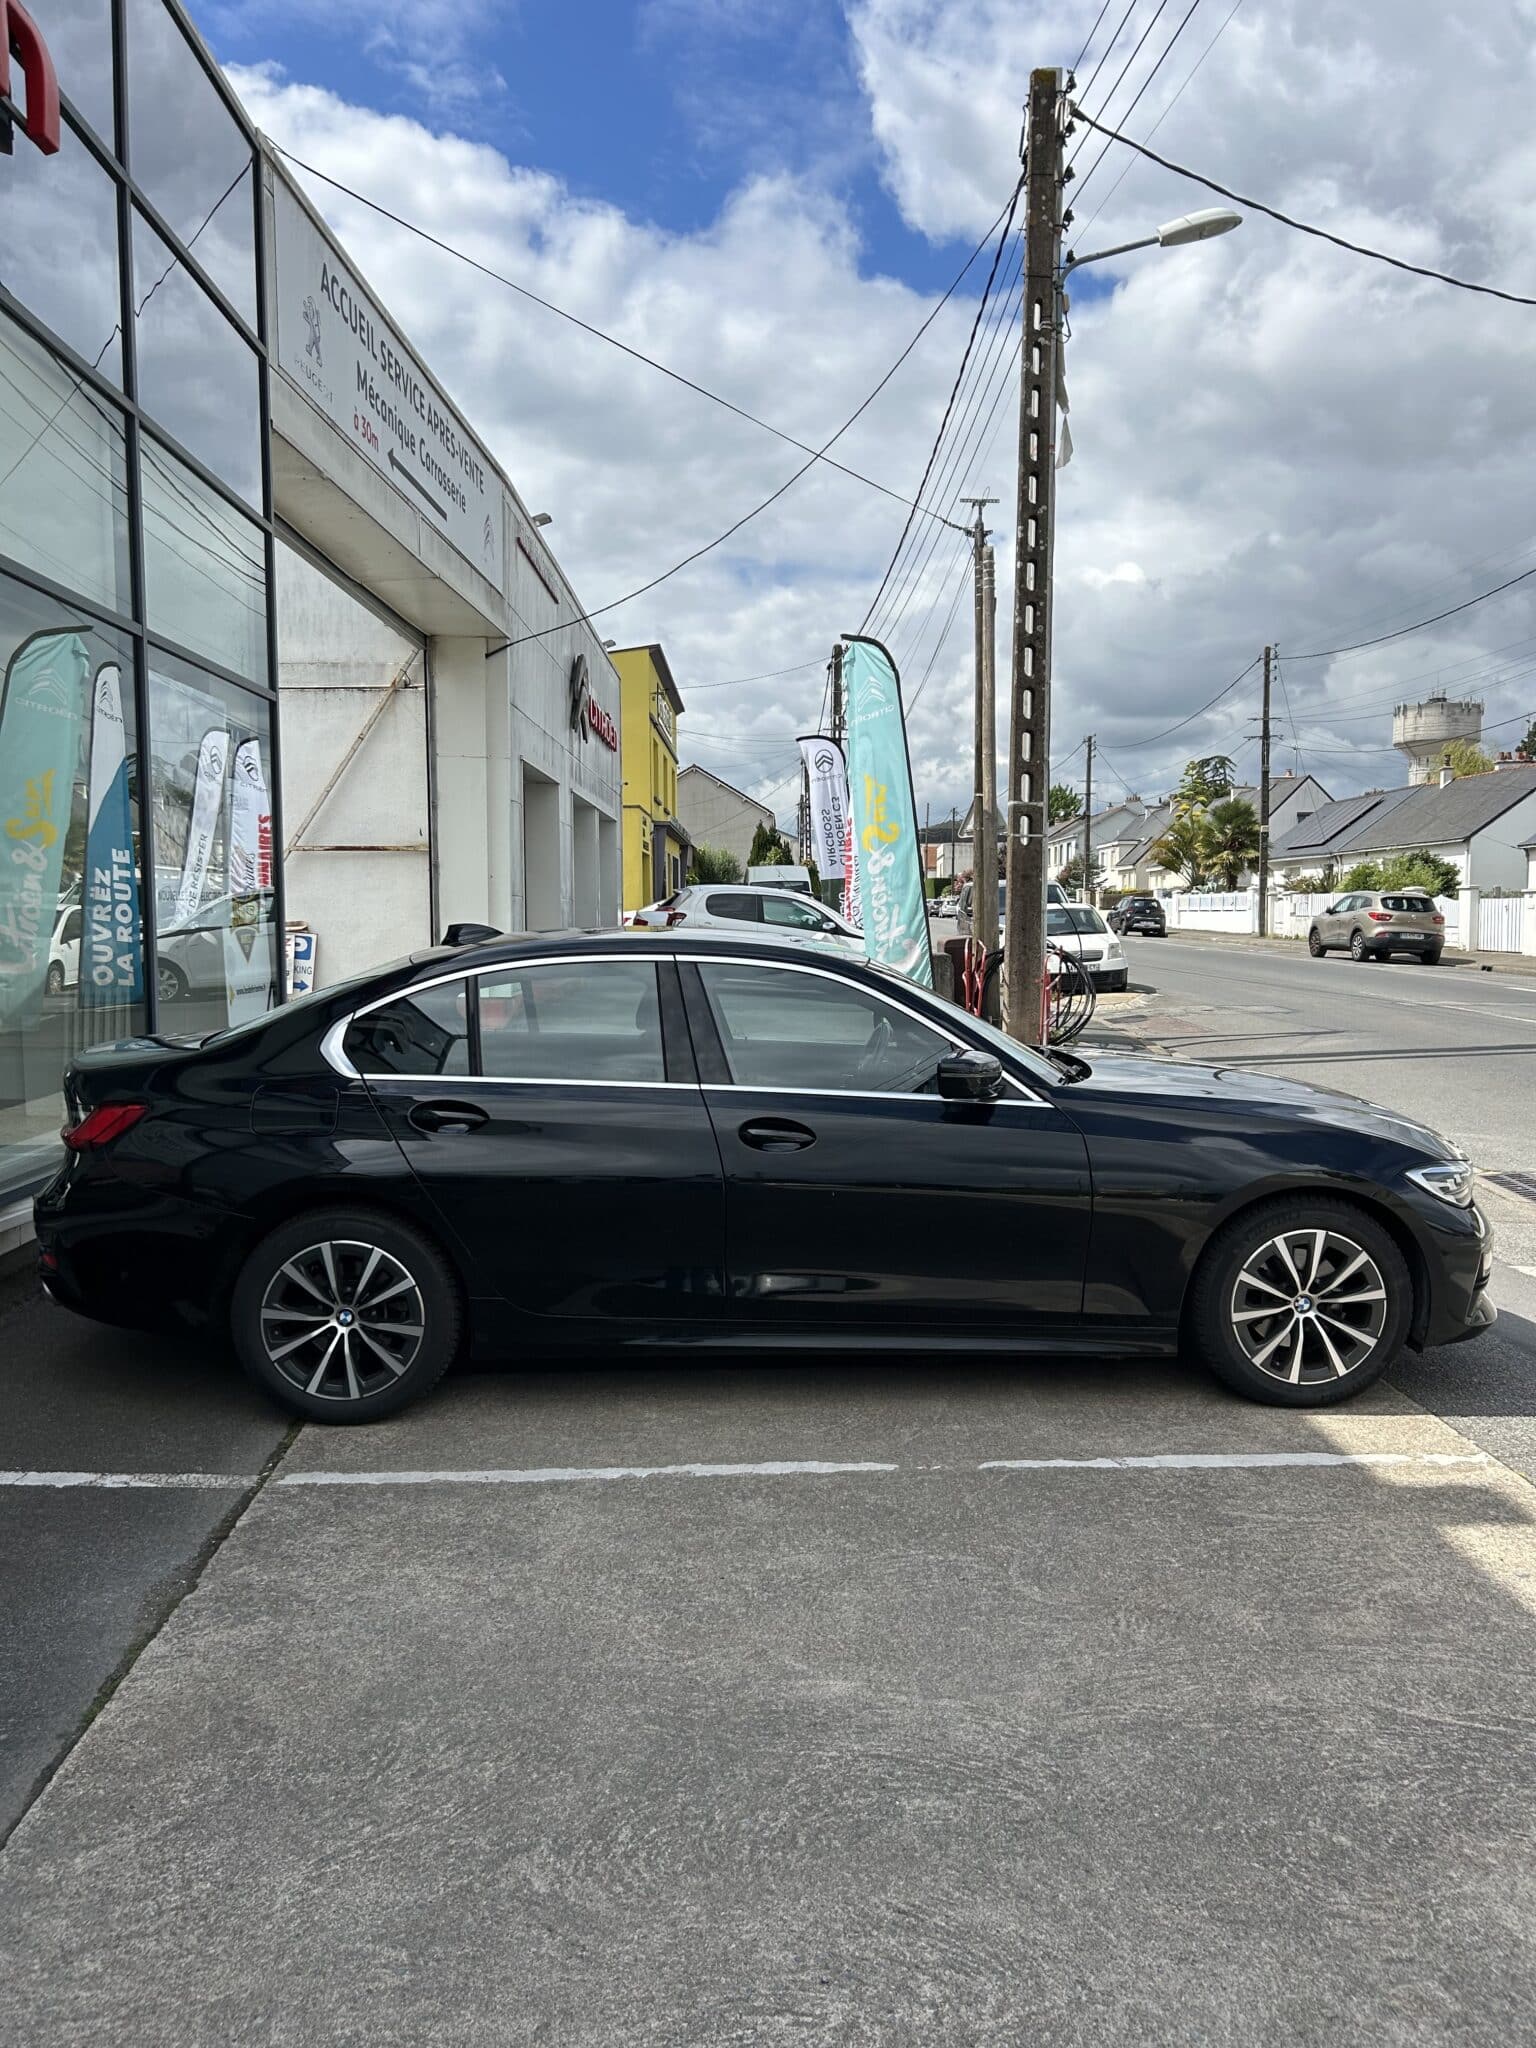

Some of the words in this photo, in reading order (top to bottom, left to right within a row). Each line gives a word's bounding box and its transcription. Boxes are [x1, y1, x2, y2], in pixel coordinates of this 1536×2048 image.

[320, 262, 378, 362] ACCUEIL
[380, 339, 426, 421] SERVICE
[427, 407, 485, 495] APRÈS-VENTE
[356, 359, 417, 456] Mécanique
[419, 438, 467, 513] Carrosserie
[361, 415, 379, 453] 30m
[111, 848, 133, 943] ROUTE
[117, 953, 135, 986] LA
[294, 964, 313, 976] KING
